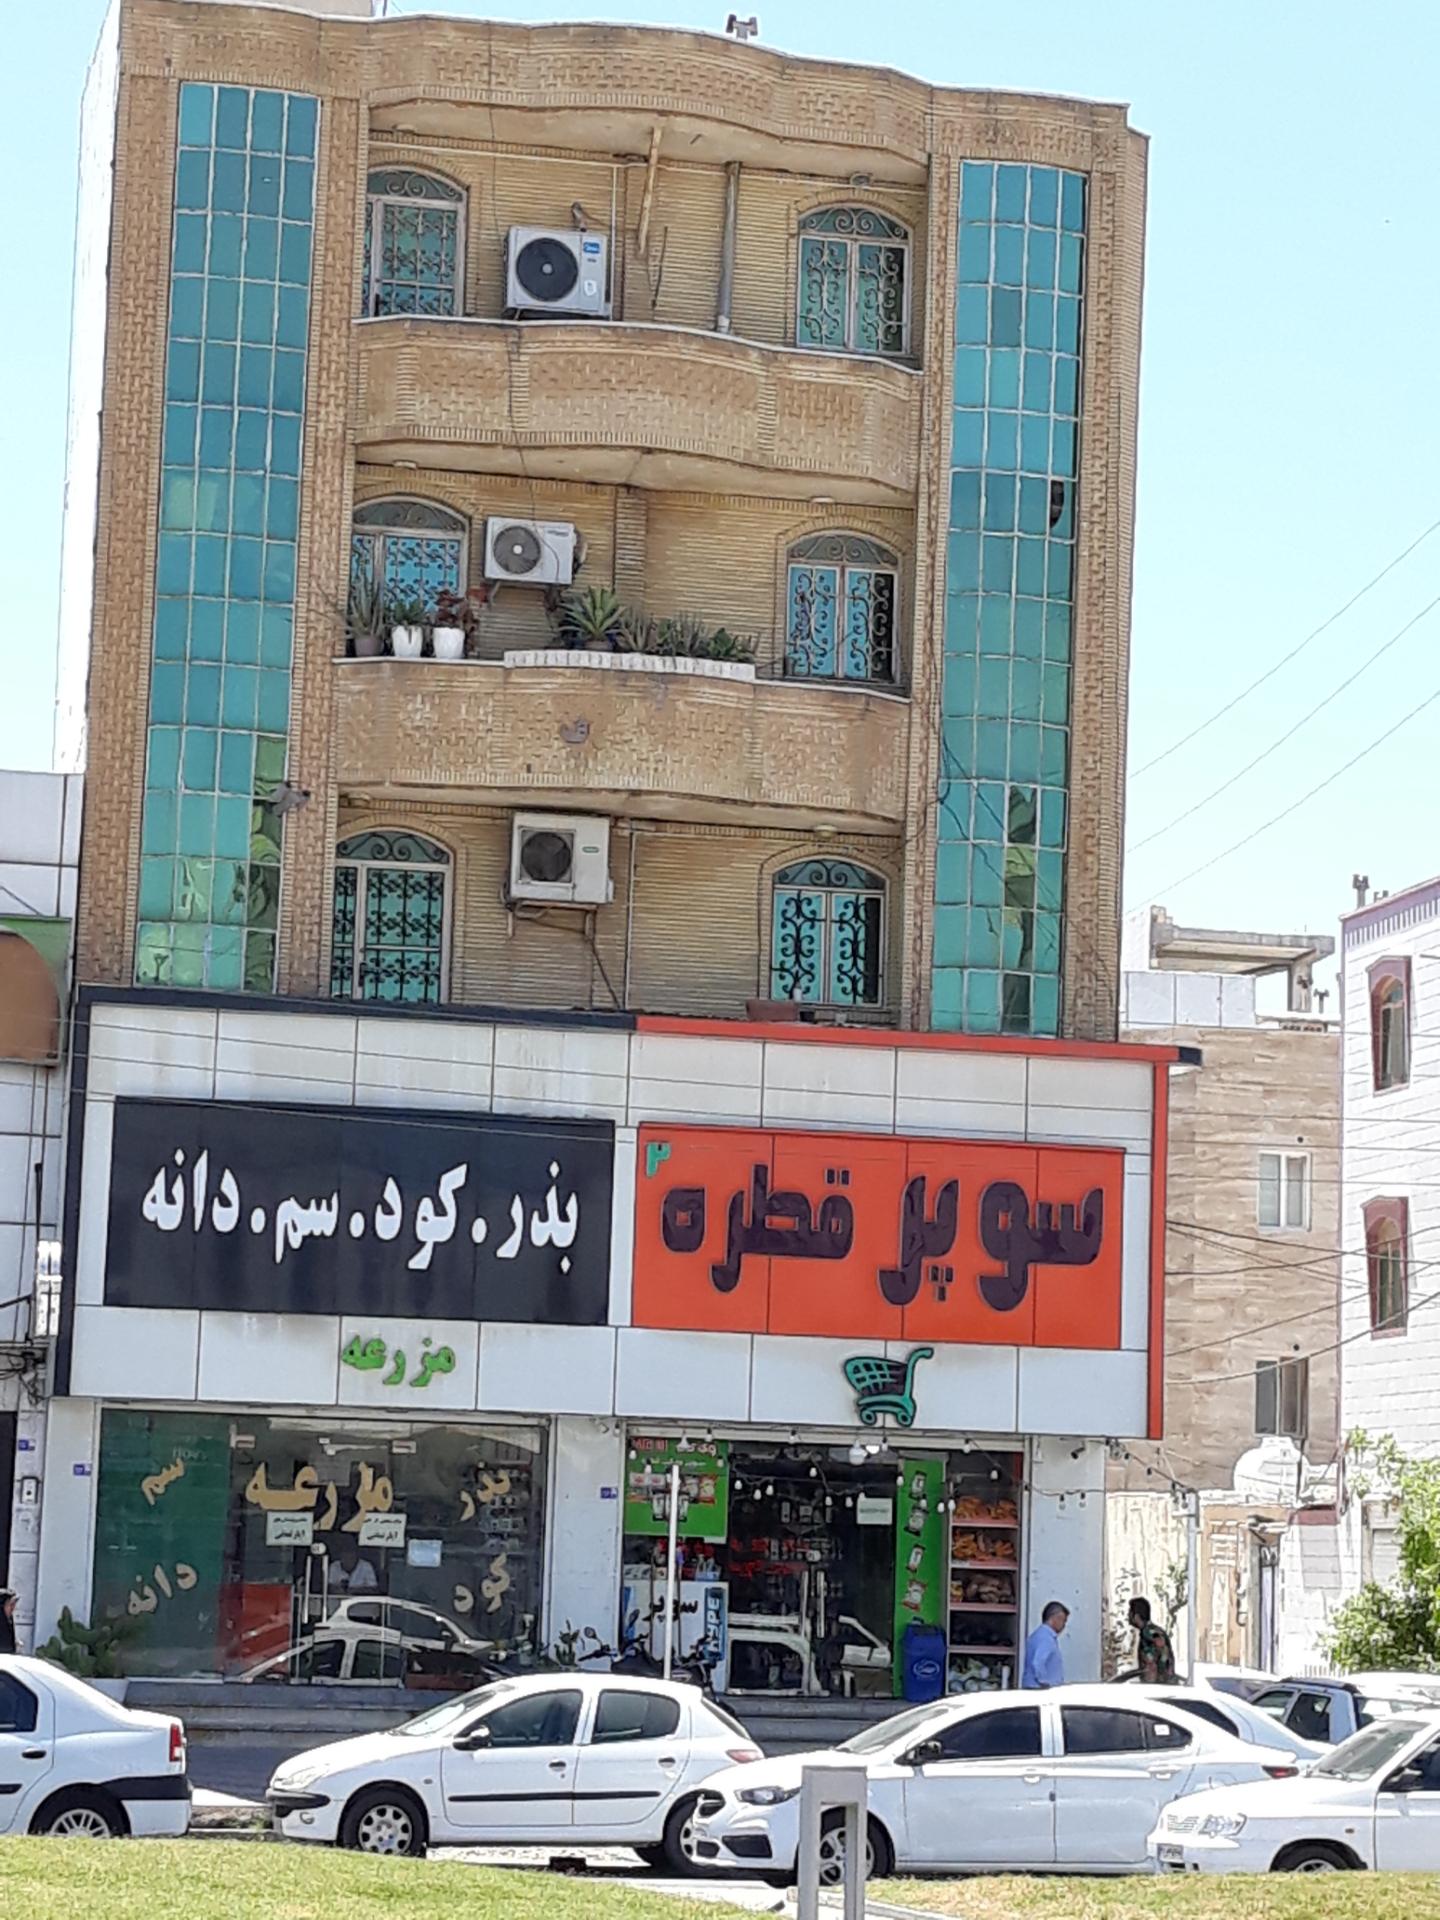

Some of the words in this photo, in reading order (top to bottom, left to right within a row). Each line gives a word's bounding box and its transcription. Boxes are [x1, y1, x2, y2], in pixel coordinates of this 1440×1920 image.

[661, 1163, 856, 1293] قطره
[877, 1174, 1105, 1313] سوپر
[341, 1336, 457, 1388] مزرعه
[141, 1457, 185, 1506] سم
[244, 1460, 394, 1533] مزرعه
[127, 1562, 198, 1616] دانه
